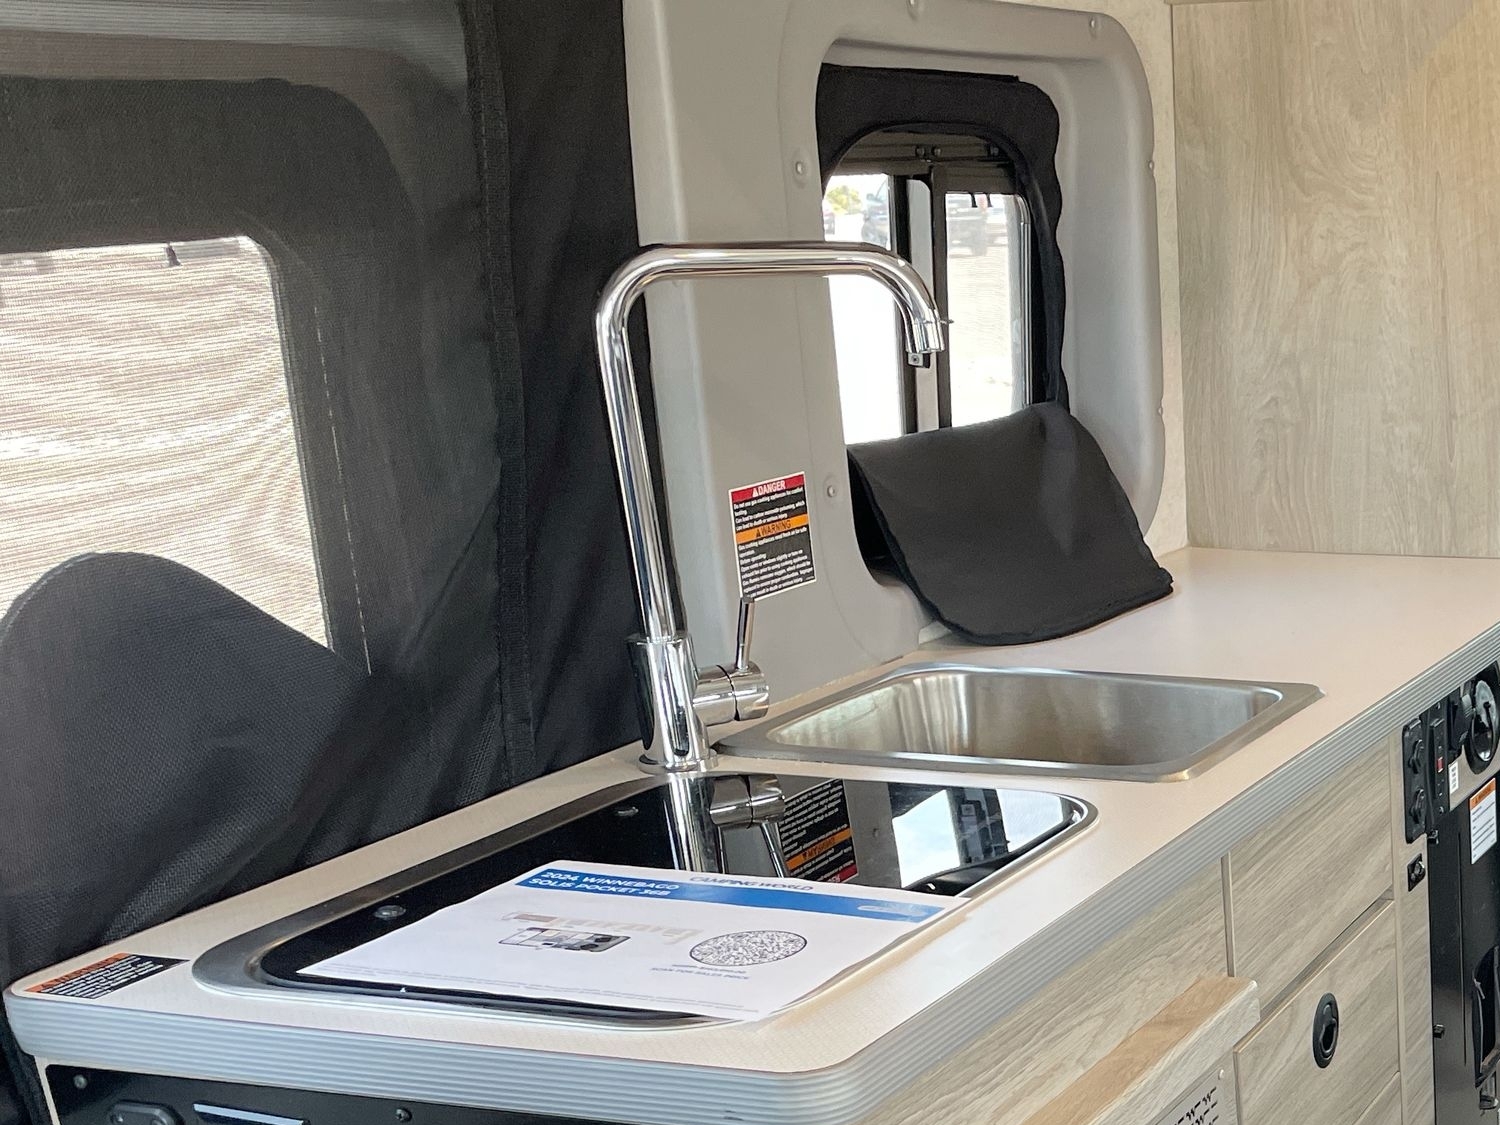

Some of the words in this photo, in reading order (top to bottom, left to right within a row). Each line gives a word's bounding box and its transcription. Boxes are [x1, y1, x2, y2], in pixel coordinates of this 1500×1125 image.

[758, 480, 786, 495] DANGER
[760, 520, 792, 536] WARNING
[529, 878, 576, 888] SOLIS
[576, 883, 639, 894] POCKET
[541, 872, 578, 882] 2024
[583, 876, 680, 890] WINNEBAGO
[690, 876, 755, 886] CAMPING
